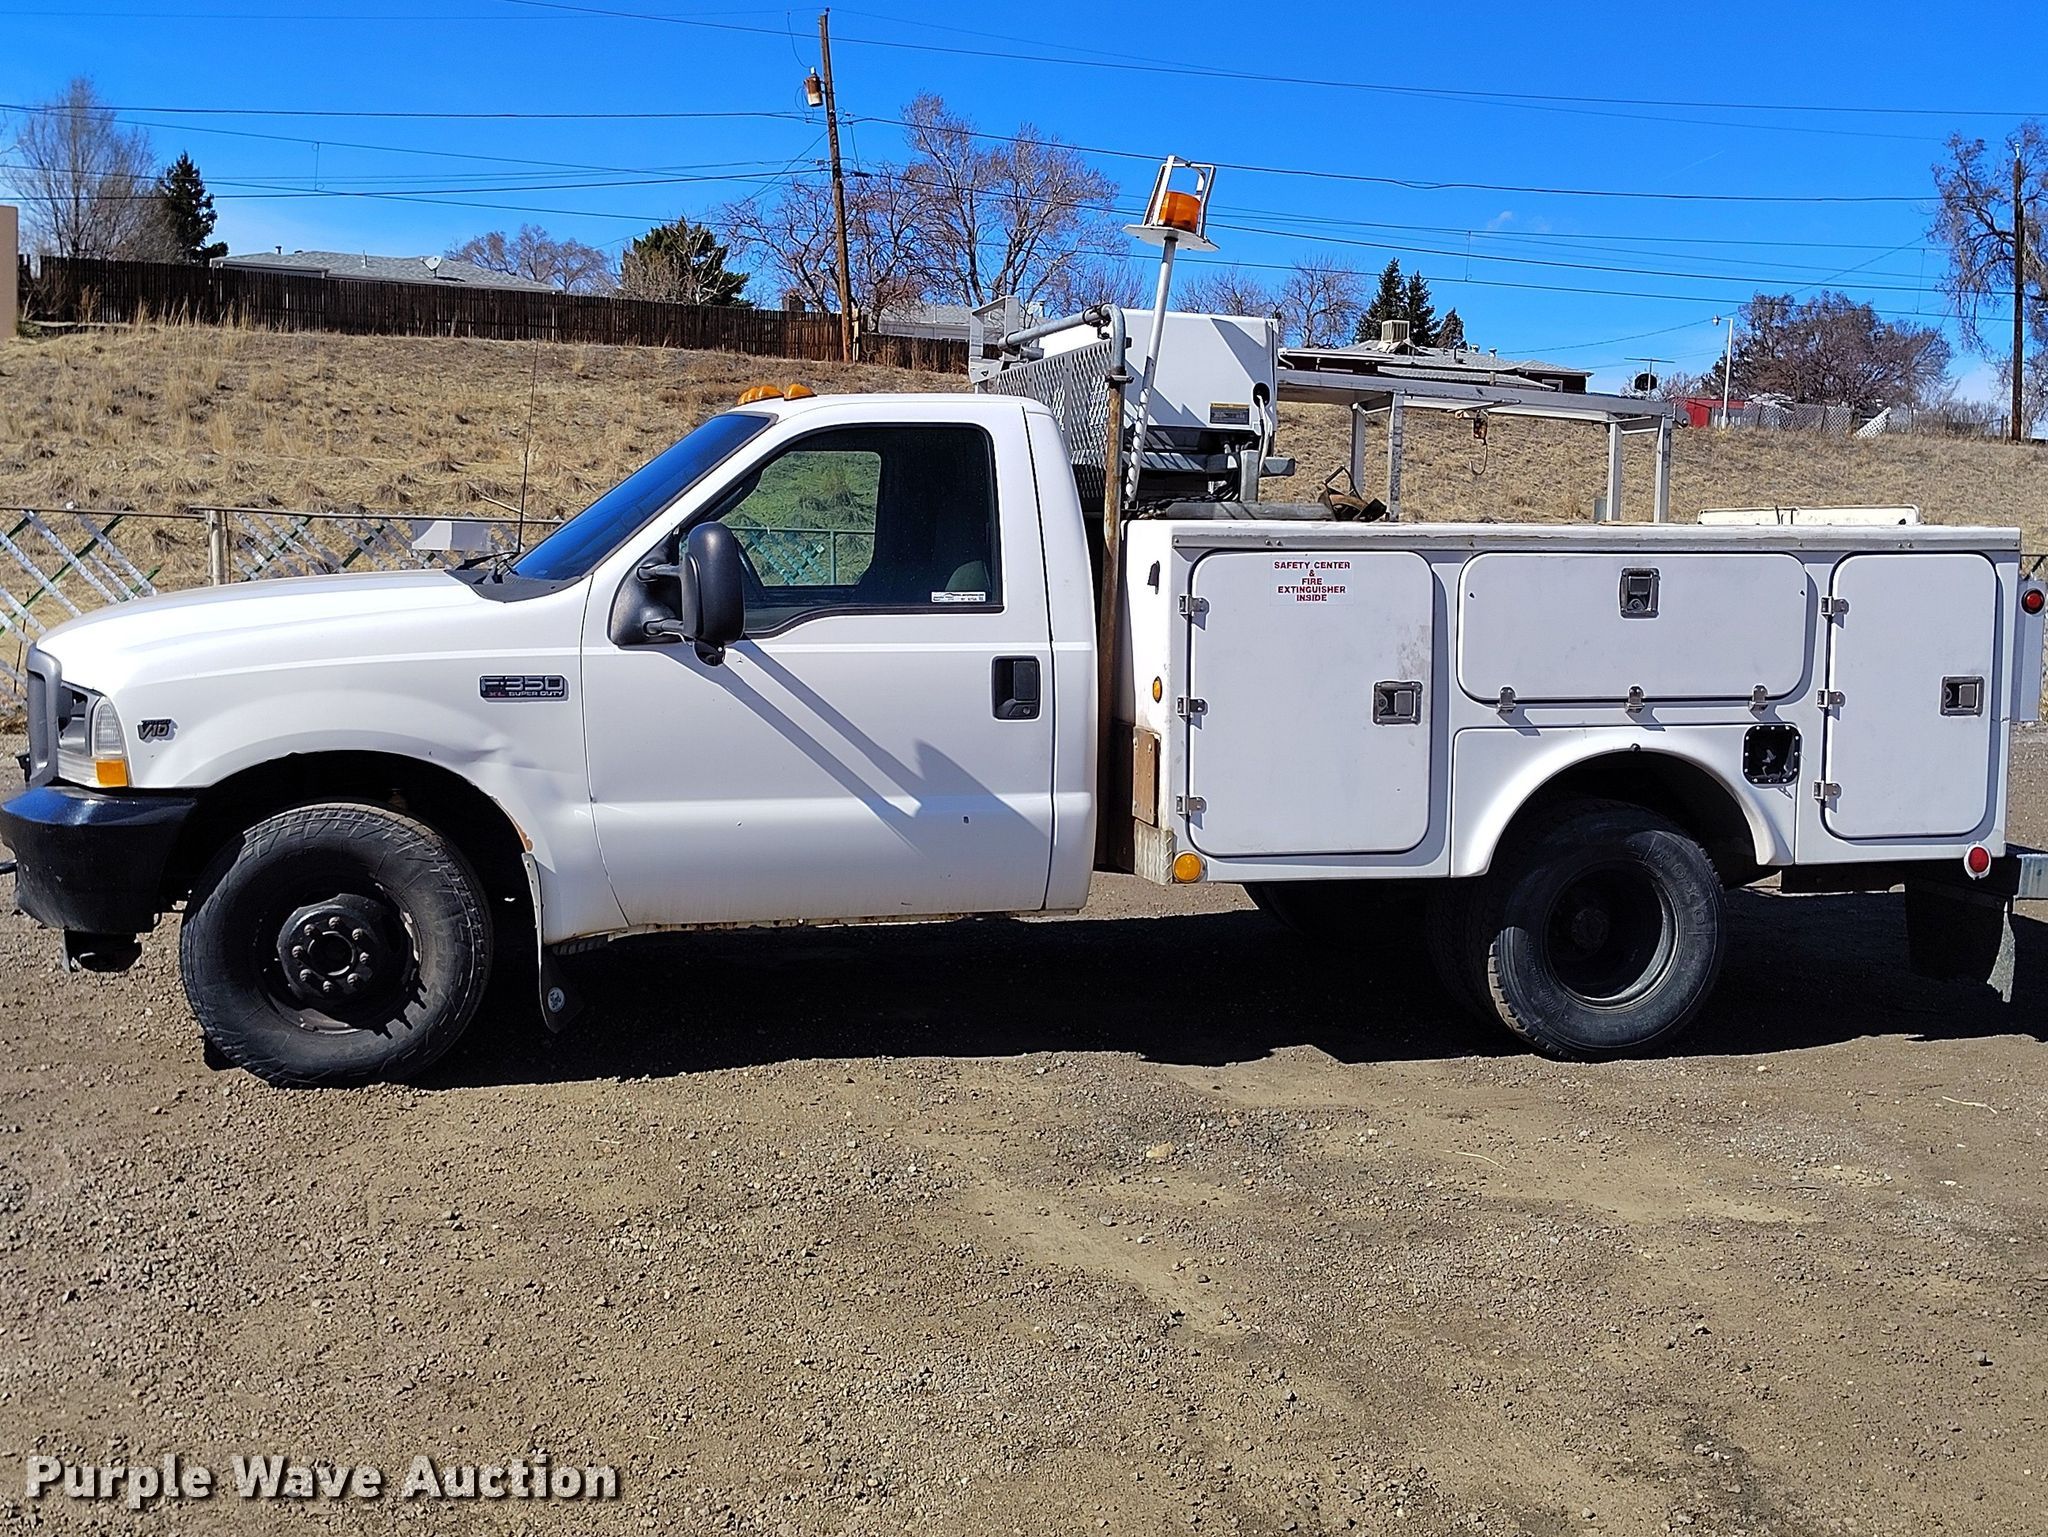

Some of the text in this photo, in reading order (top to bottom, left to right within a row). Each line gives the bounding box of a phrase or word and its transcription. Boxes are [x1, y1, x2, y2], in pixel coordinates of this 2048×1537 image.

[1274, 561, 1350, 569] SAFETY CENTER
[1308, 569, 1315, 577] &
[1277, 586, 1346, 594] EXTINGUISHER
[1296, 594, 1328, 602] INSIDE
[137, 724, 169, 740] V10
